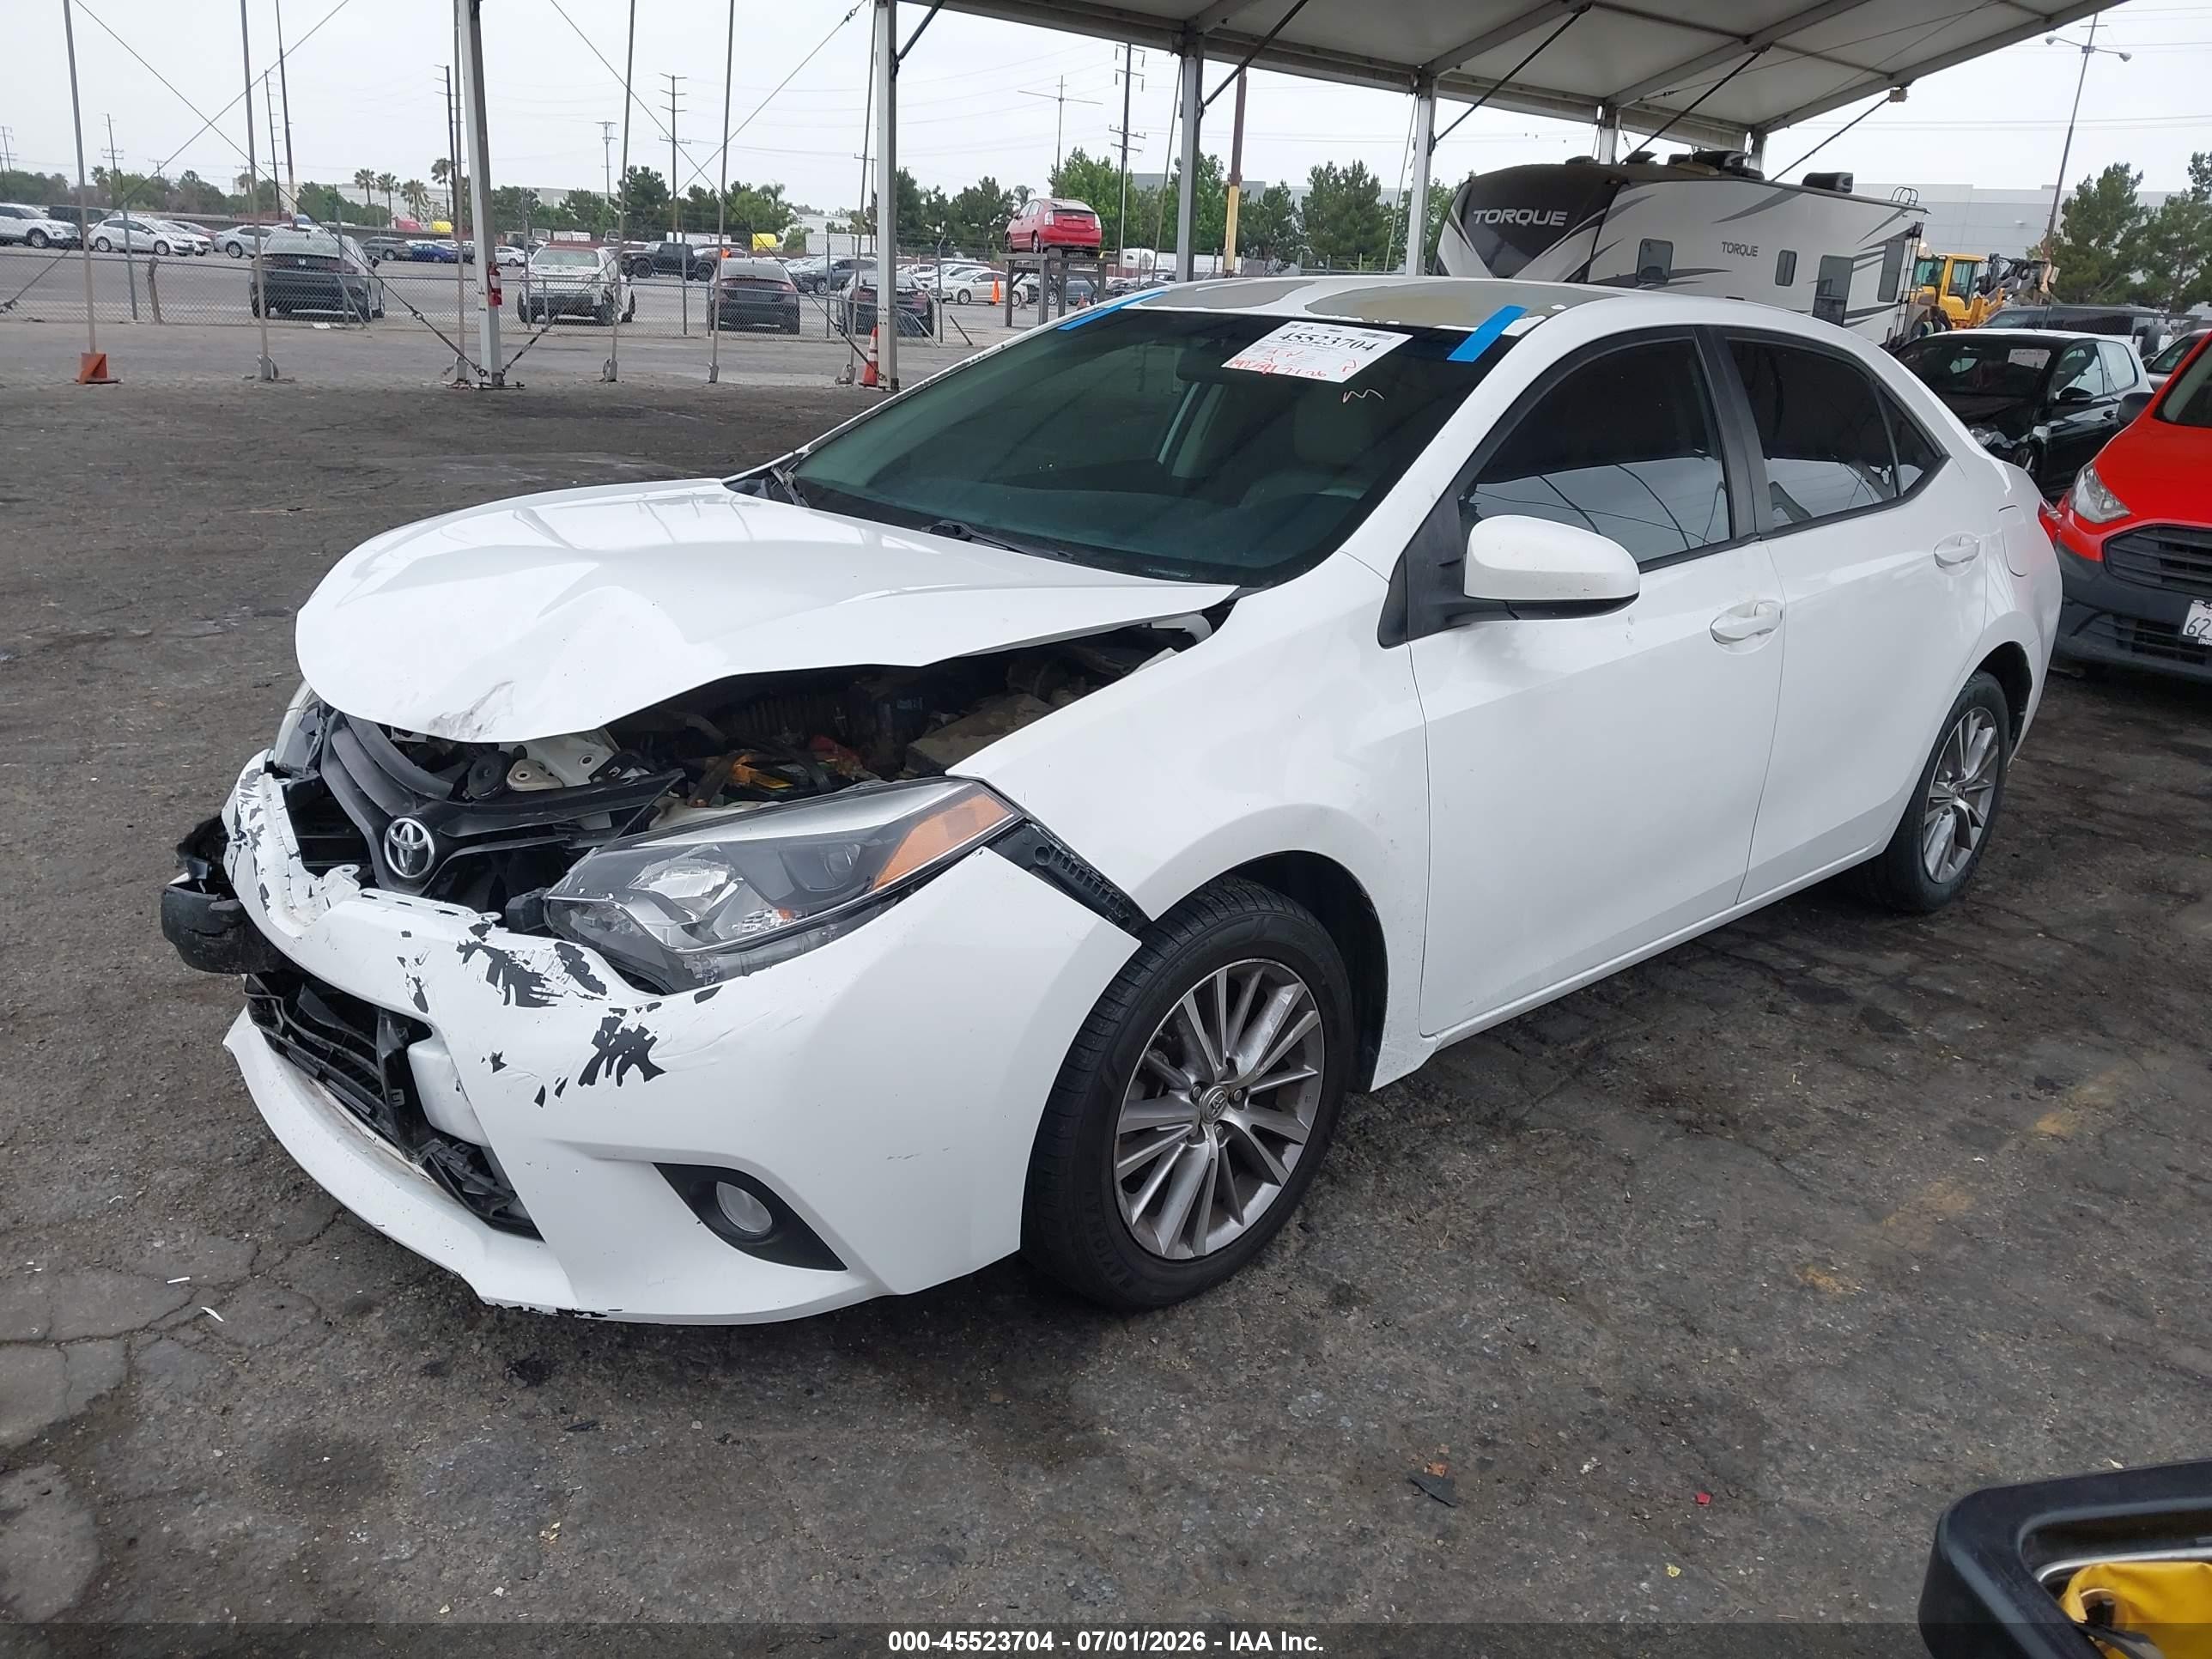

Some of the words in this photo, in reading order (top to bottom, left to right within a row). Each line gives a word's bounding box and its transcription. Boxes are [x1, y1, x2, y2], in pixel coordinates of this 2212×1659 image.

[1473, 208, 1568, 227] TORQUE
[1721, 240, 1759, 258] TORQUE
[1279, 331, 1379, 352] 45523704
